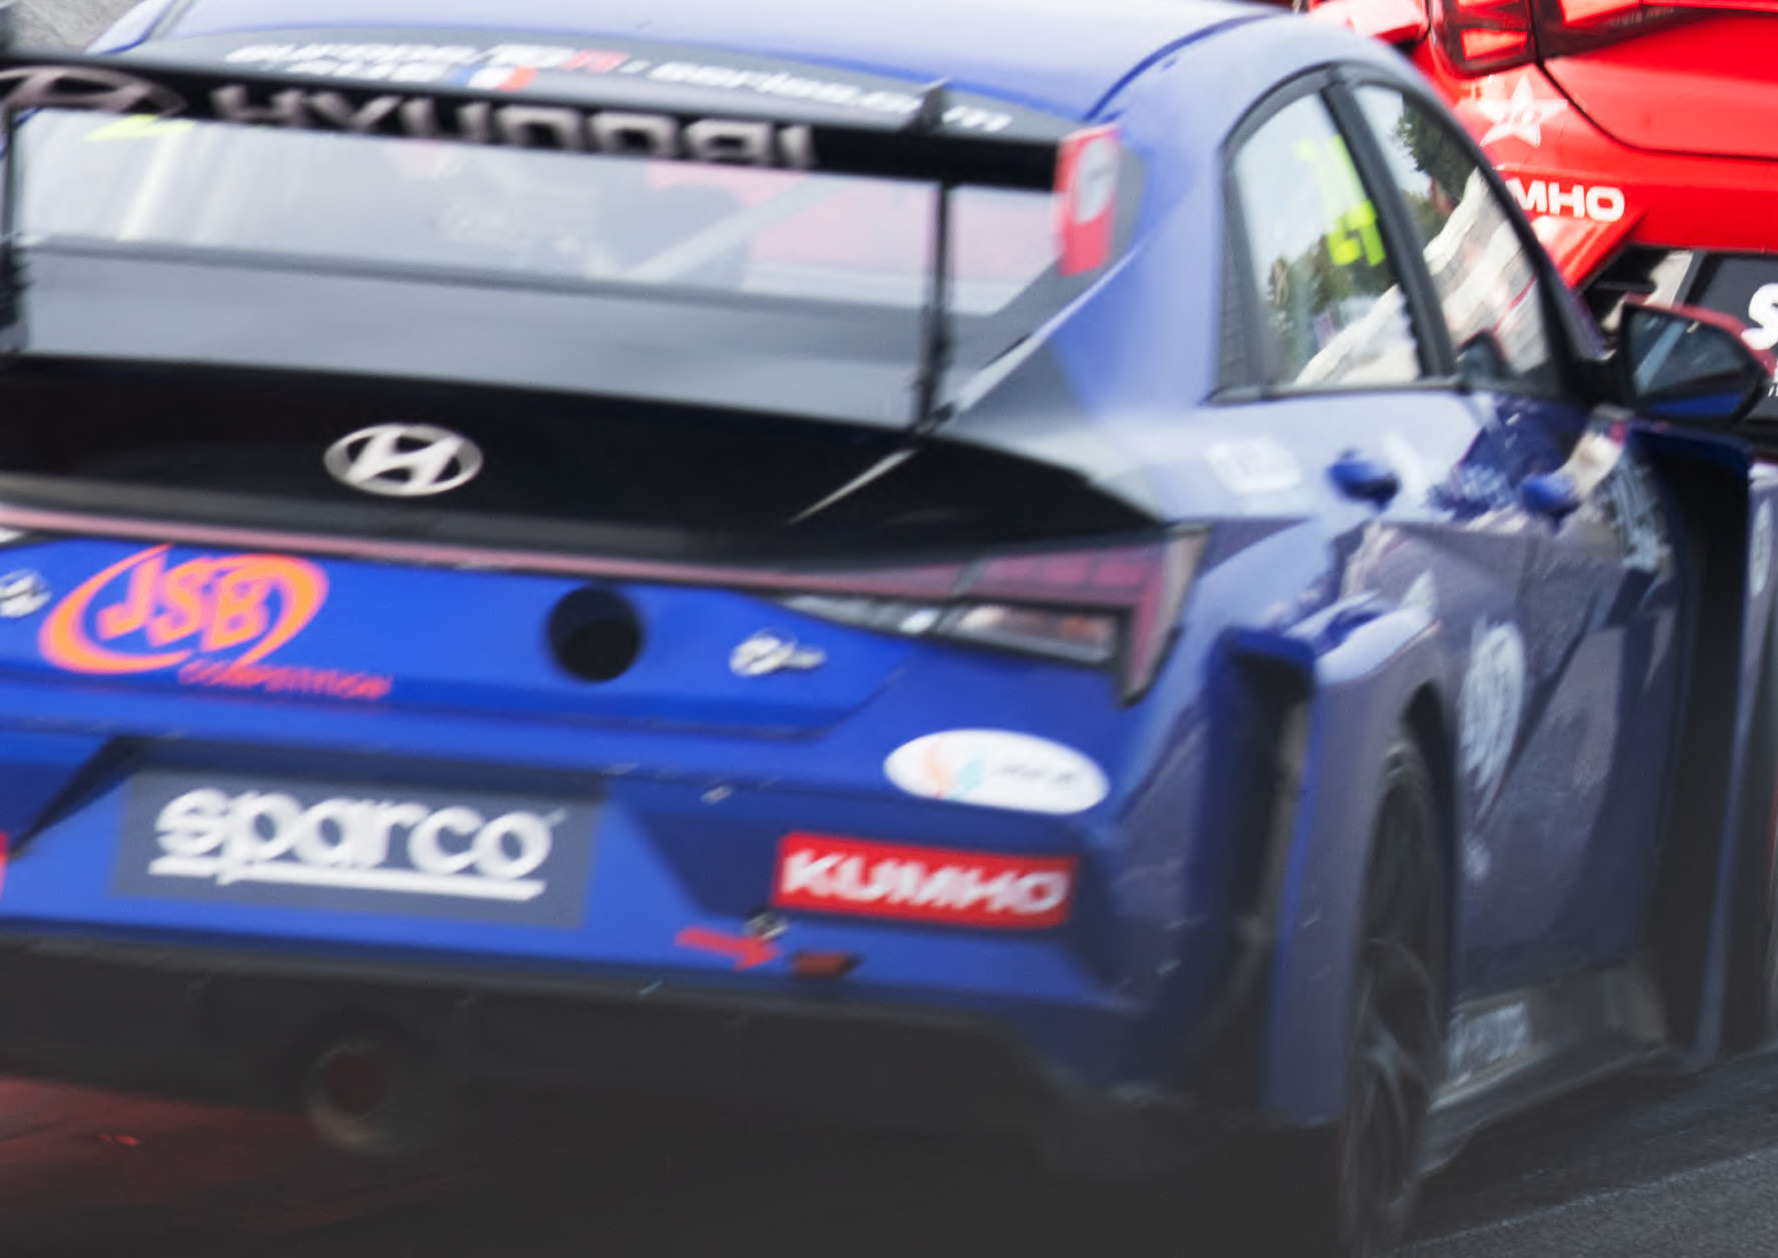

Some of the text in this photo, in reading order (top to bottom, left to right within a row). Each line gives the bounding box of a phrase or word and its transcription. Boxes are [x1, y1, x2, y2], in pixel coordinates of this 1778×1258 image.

[1505, 177, 1625, 222] MHO
[96, 551, 270, 651] JSB
[153, 788, 556, 887] sparco
[779, 848, 1070, 913] KUMHO
